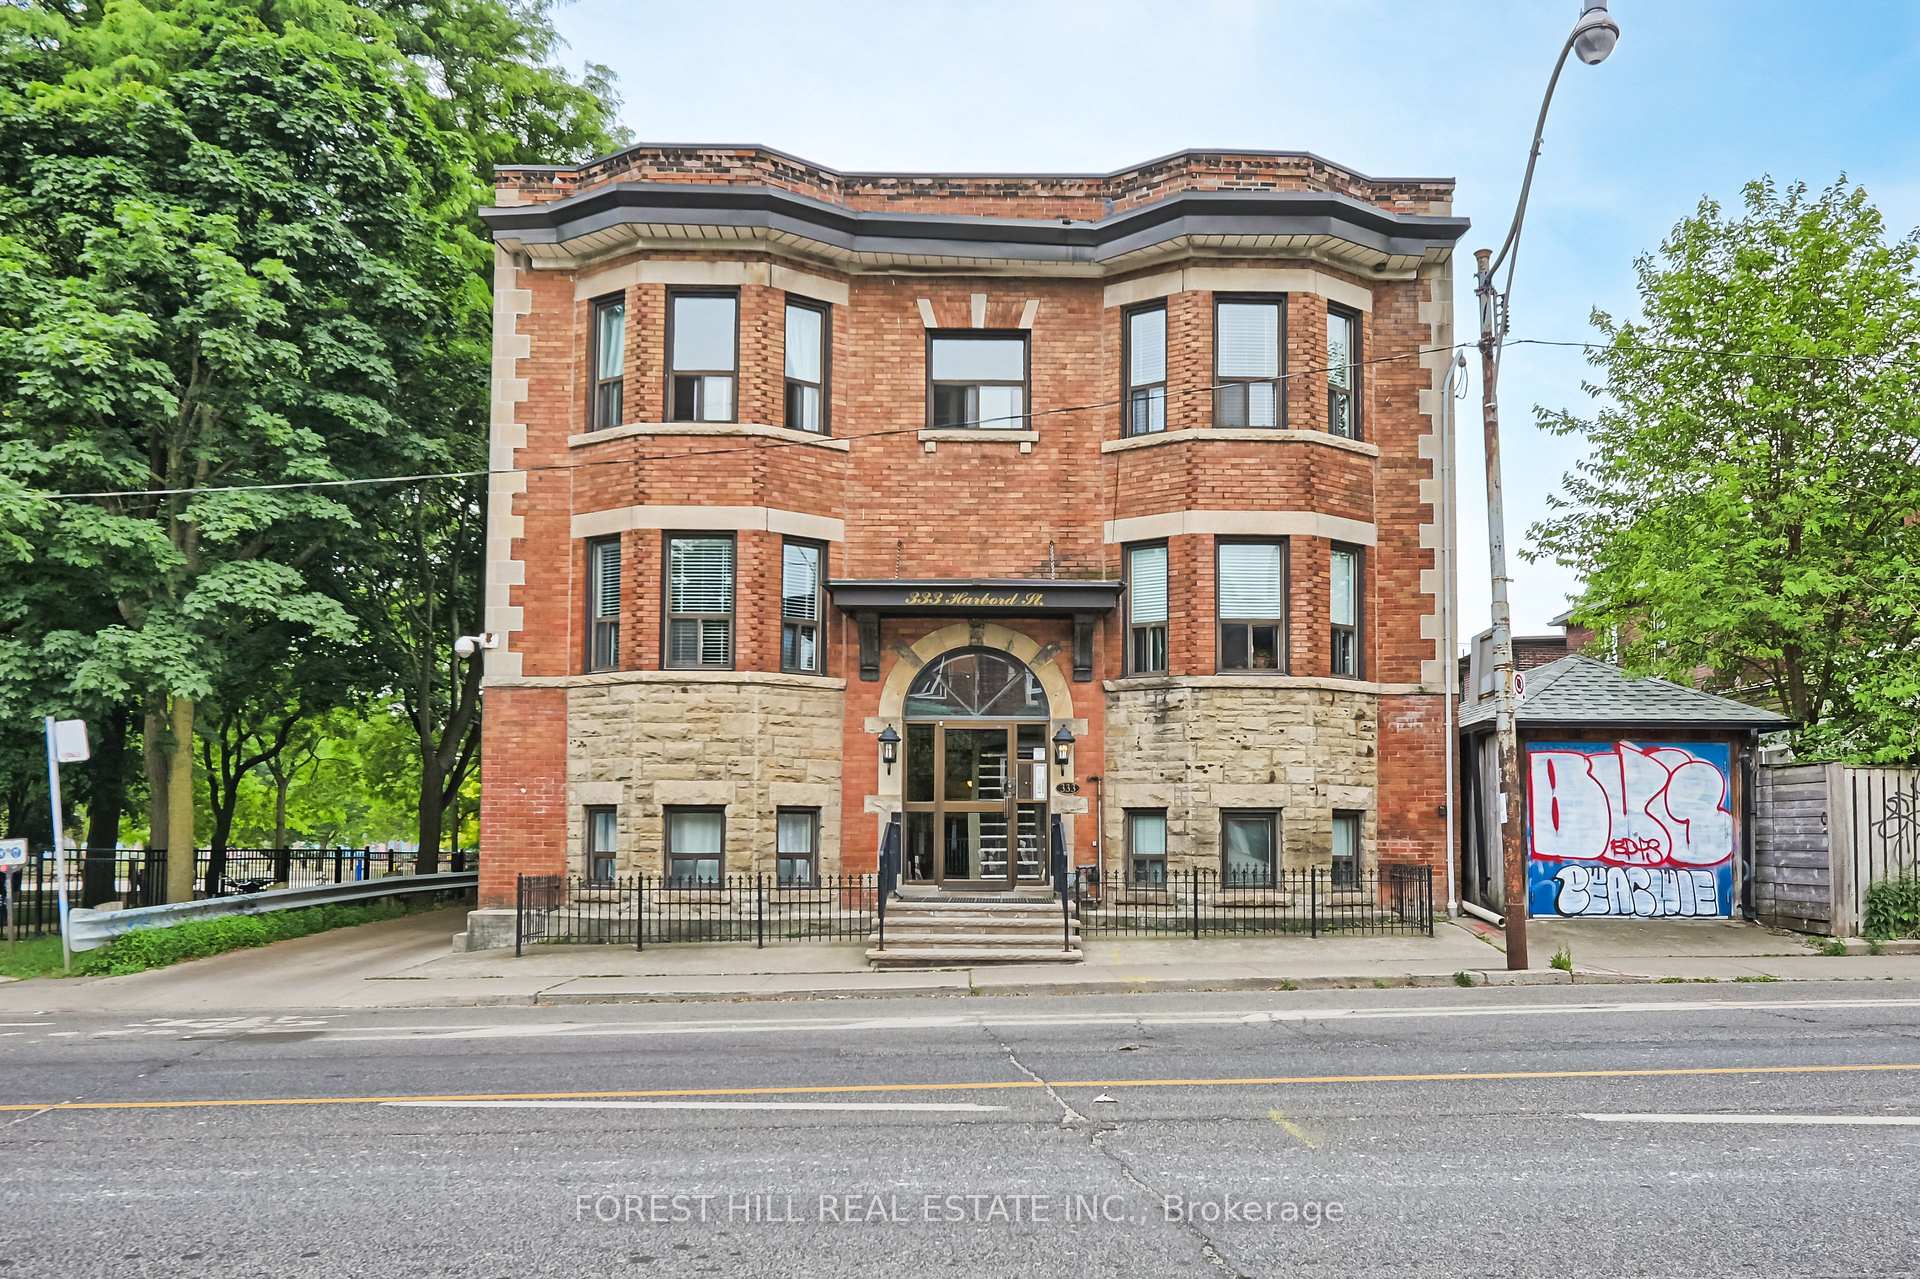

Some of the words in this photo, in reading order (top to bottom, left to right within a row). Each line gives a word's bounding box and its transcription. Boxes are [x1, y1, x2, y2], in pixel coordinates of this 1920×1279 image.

[905, 591, 944, 605] 333
[945, 592, 1019, 607] Harbord
[1021, 592, 1044, 607] St.
[1060, 783, 1076, 793] 333
